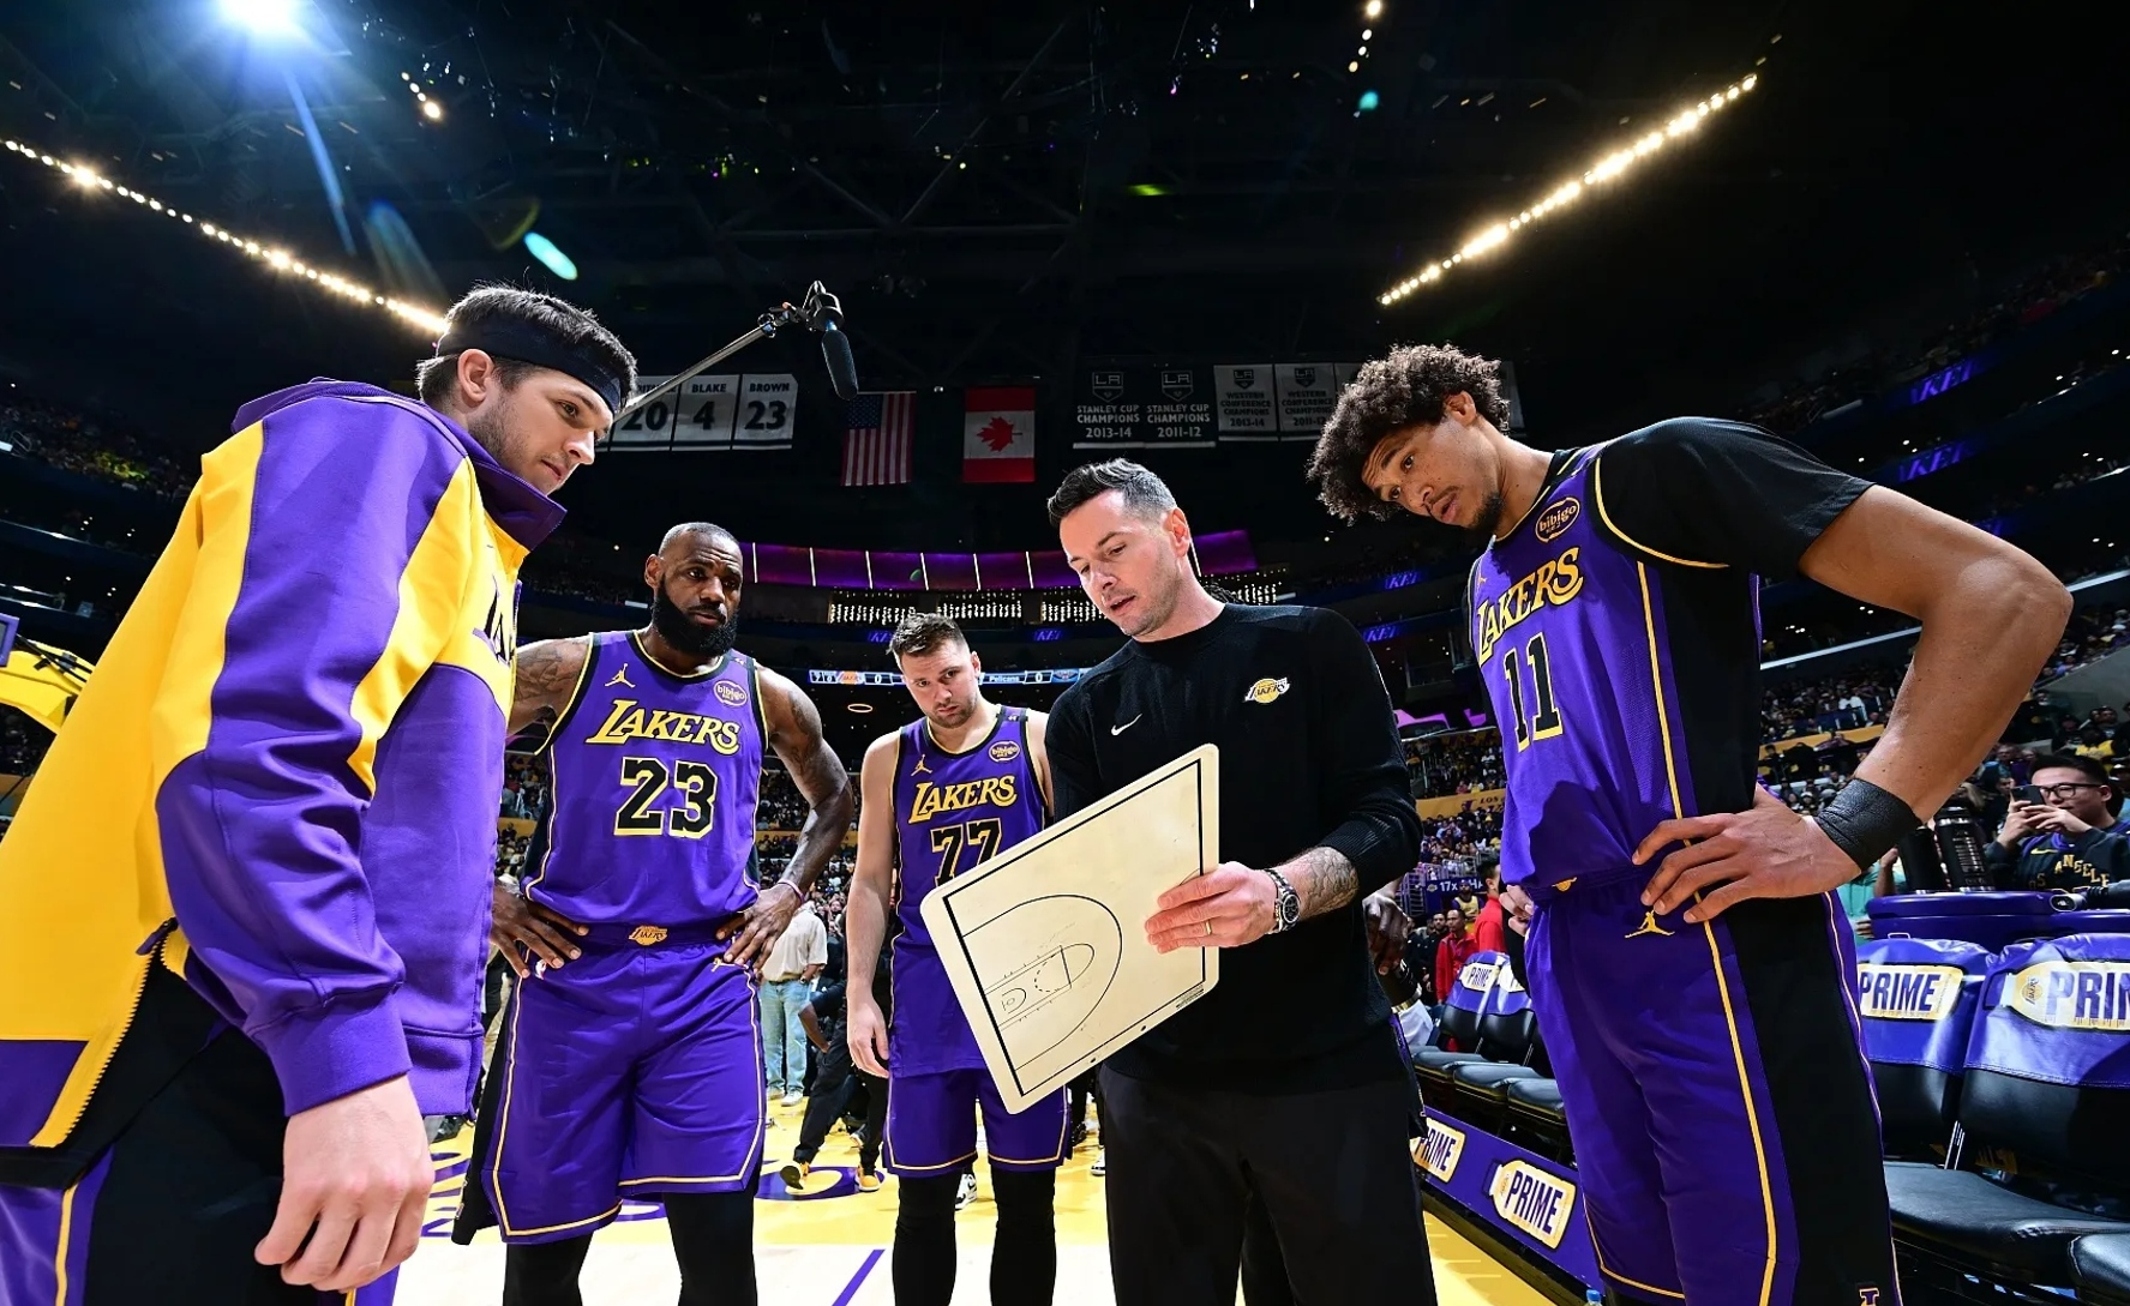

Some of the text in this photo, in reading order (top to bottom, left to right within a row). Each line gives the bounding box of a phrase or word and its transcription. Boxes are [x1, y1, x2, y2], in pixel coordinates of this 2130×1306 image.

[1095, 375, 1121, 385] LA
[1164, 374, 1190, 384] LA
[692, 383, 727, 393] BLAKE
[750, 382, 790, 392] BROWN
[1077, 404, 1140, 414] STANLEY CUP
[1147, 404, 1210, 413] STANLEY CUP
[1224, 408, 1270, 416] CHAMPIONS
[621, 401, 669, 431] 20
[693, 401, 715, 431] 4
[744, 401, 788, 431] 23
[1077, 413, 1140, 424] CHAMPIONS
[1147, 413, 1211, 423] CHAMPIONS
[1085, 427, 1132, 438] 2013-14
[1157, 426, 1202, 438] 2011-12
[1539, 504, 1578, 532] bibigo
[1476, 547, 1584, 669] LAKERS
[874, 673, 883, 684] 0
[989, 674, 1020, 683] Pelicans
[1034, 672, 1043, 683] 0
[1503, 631, 1564, 752] 11
[585, 699, 741, 755] LAKERS
[614, 756, 718, 839] 23
[908, 775, 1018, 824] LAKERS
[930, 817, 1003, 887] 77
[1440, 880, 1459, 892] 17x
[1860, 971, 1941, 1012] PRIME
[1415, 1129, 1457, 1172] PRIME
[1504, 1169, 1563, 1235] PRIME
